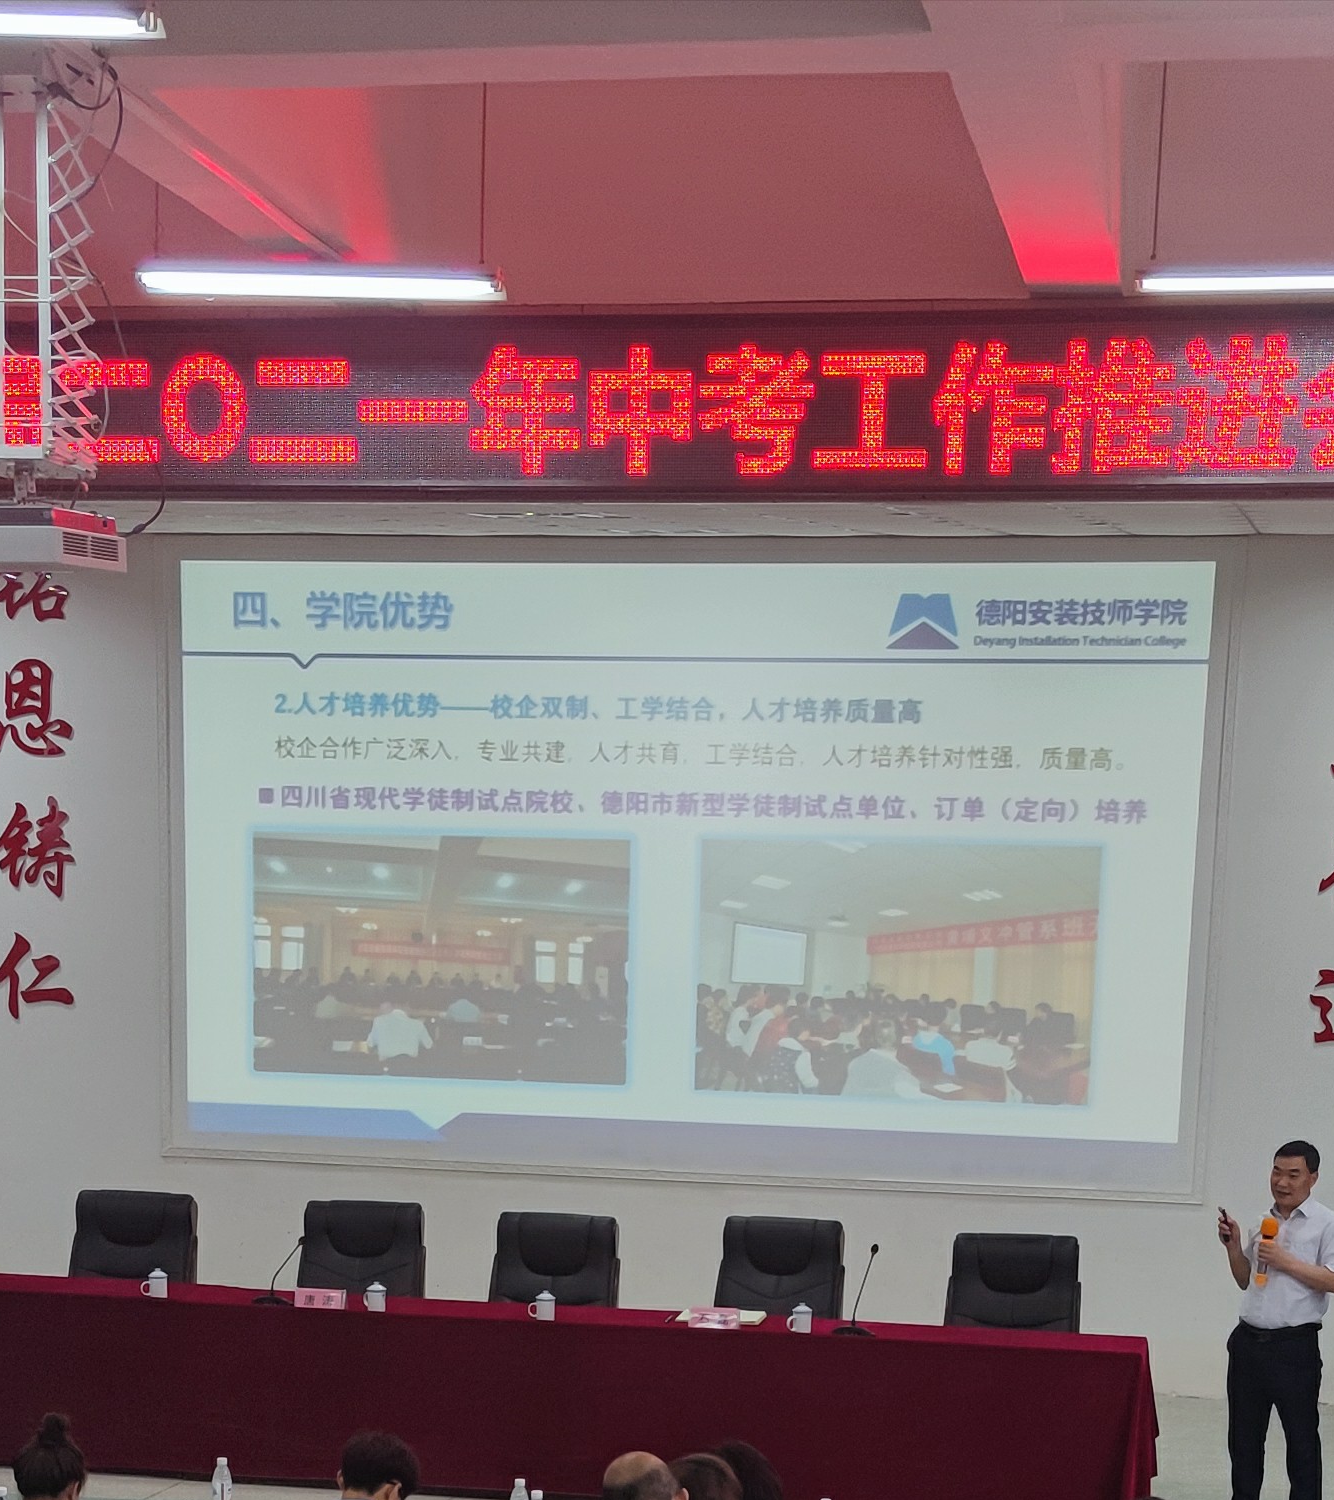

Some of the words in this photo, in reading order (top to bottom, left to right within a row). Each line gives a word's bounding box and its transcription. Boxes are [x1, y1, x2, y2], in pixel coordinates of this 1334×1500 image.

[232, 590, 454, 631] 四、学院优势
[975, 598, 1189, 627] 德阳安装技师学院
[973, 635, 1017, 649] Deyang
[1018, 635, 1080, 647] Installation
[1082, 635, 1142, 647] Technician
[1144, 635, 1188, 649] College
